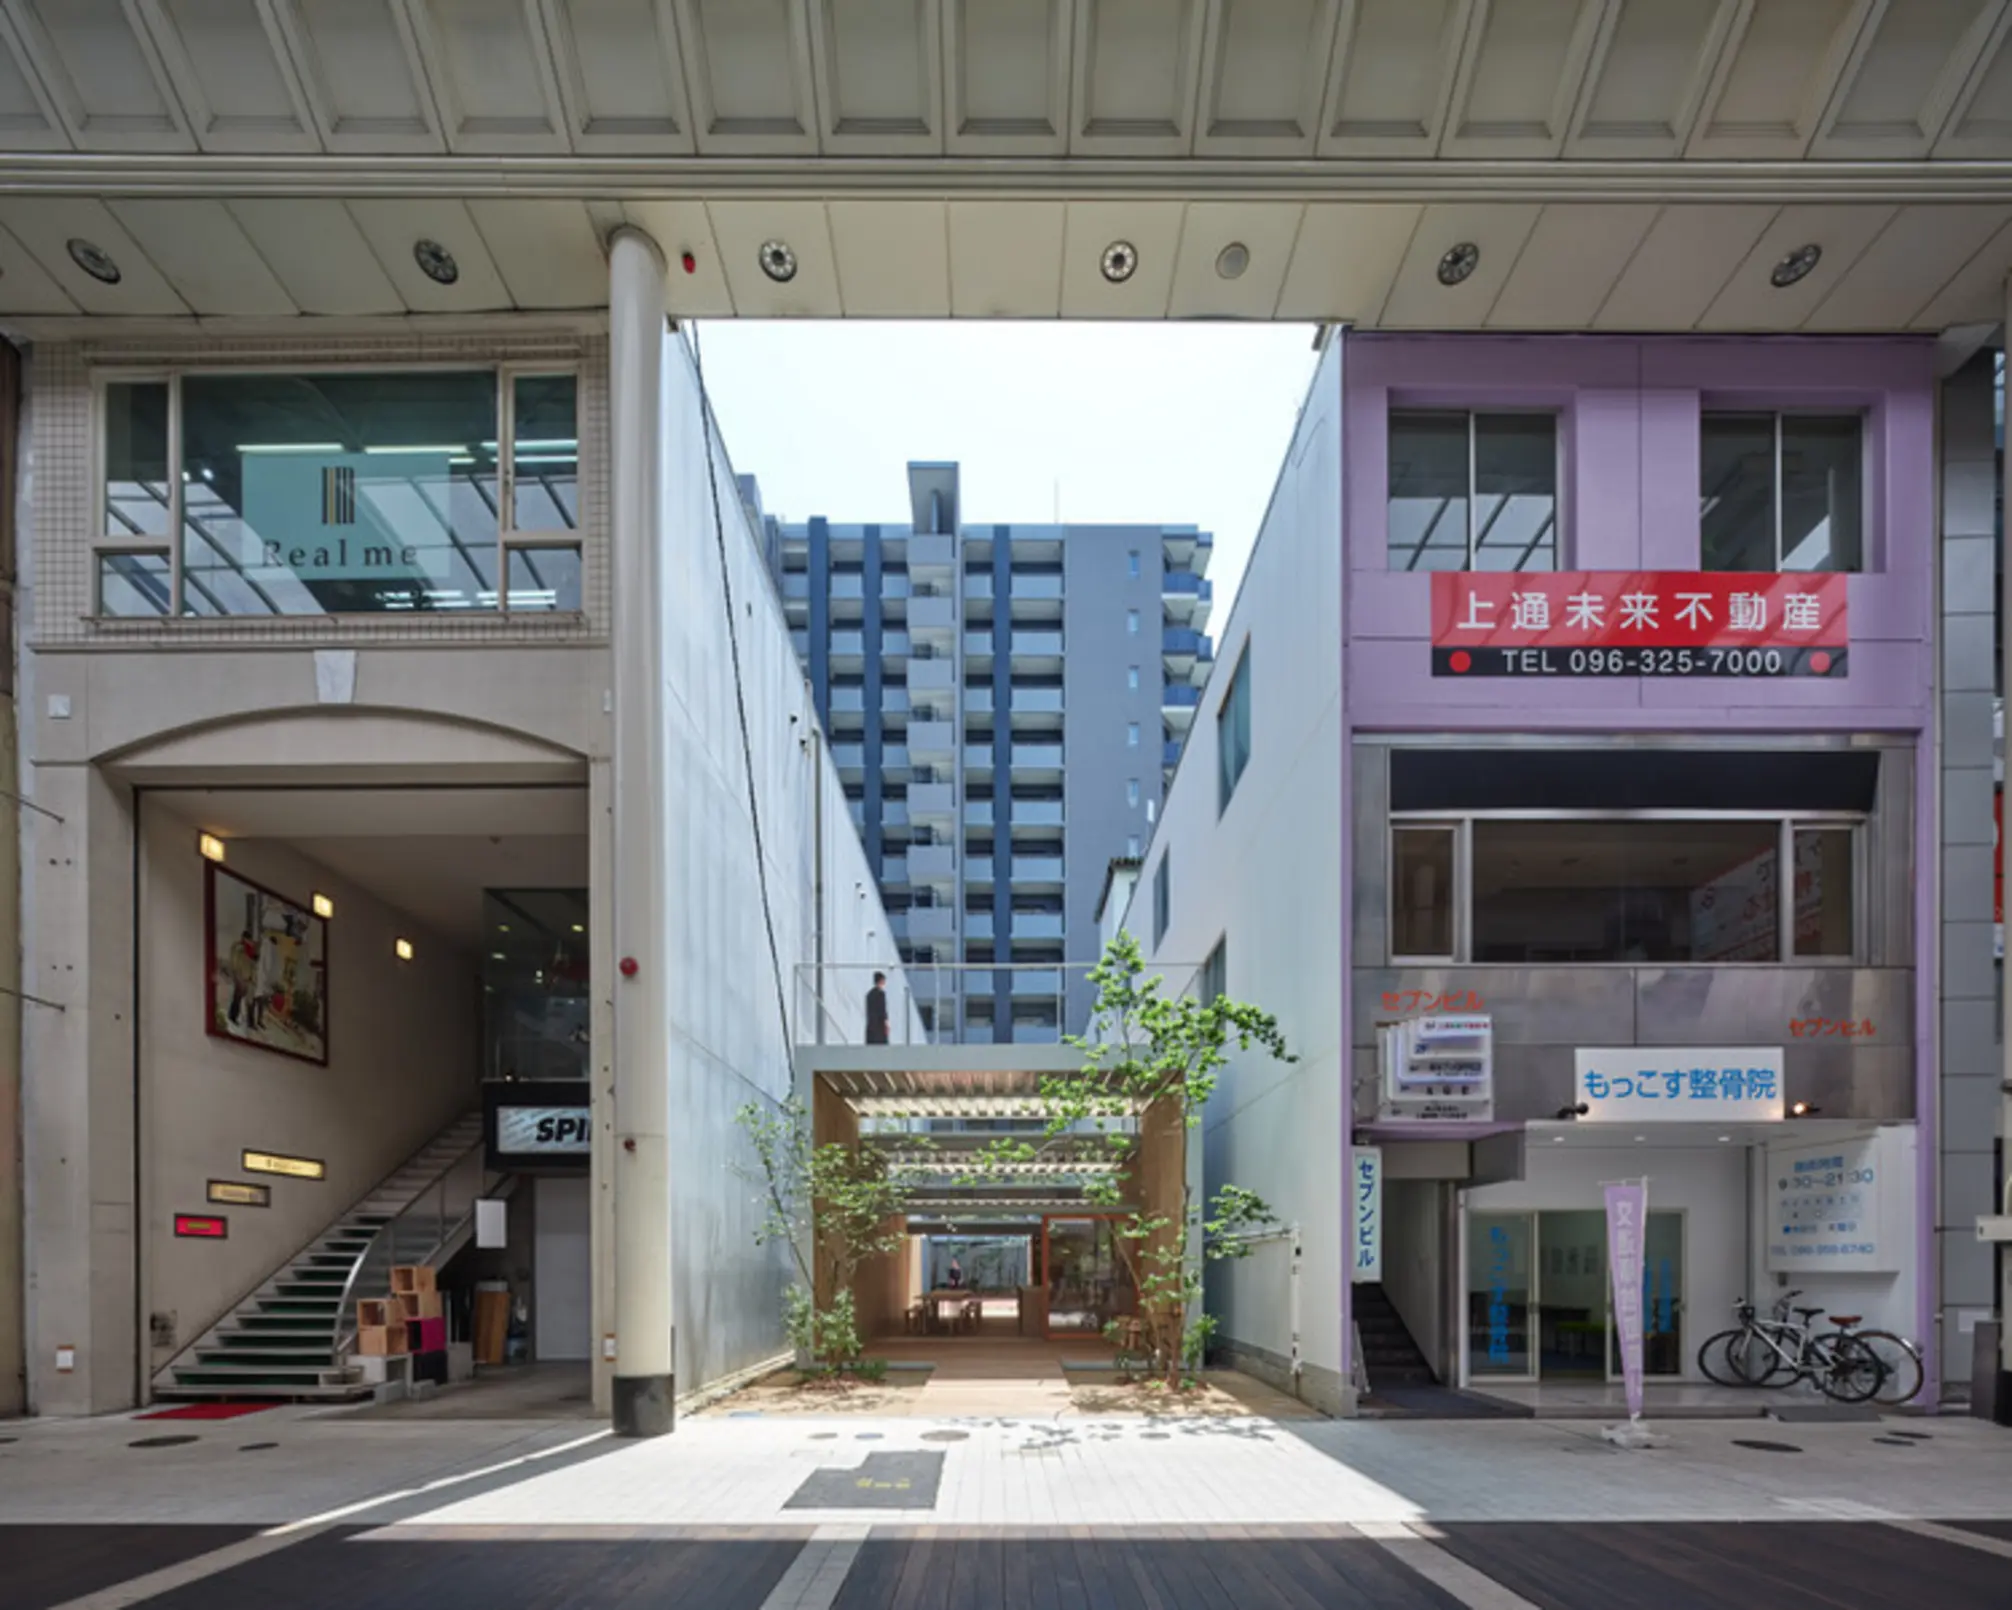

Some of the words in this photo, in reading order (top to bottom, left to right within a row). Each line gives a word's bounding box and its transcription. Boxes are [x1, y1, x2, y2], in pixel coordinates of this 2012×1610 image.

[262, 539, 347, 567] Real
[364, 545, 418, 566] me
[1456, 590, 1823, 631] 上通未来不動産
[1502, 649, 1558, 672] TEL
[1569, 648, 1783, 674] 096-325-7000
[1381, 989, 1486, 1012] セブンビル
[1584, 1068, 1776, 1100] もっこす整骨院
[1358, 1159, 1376, 1268] セブンビル
